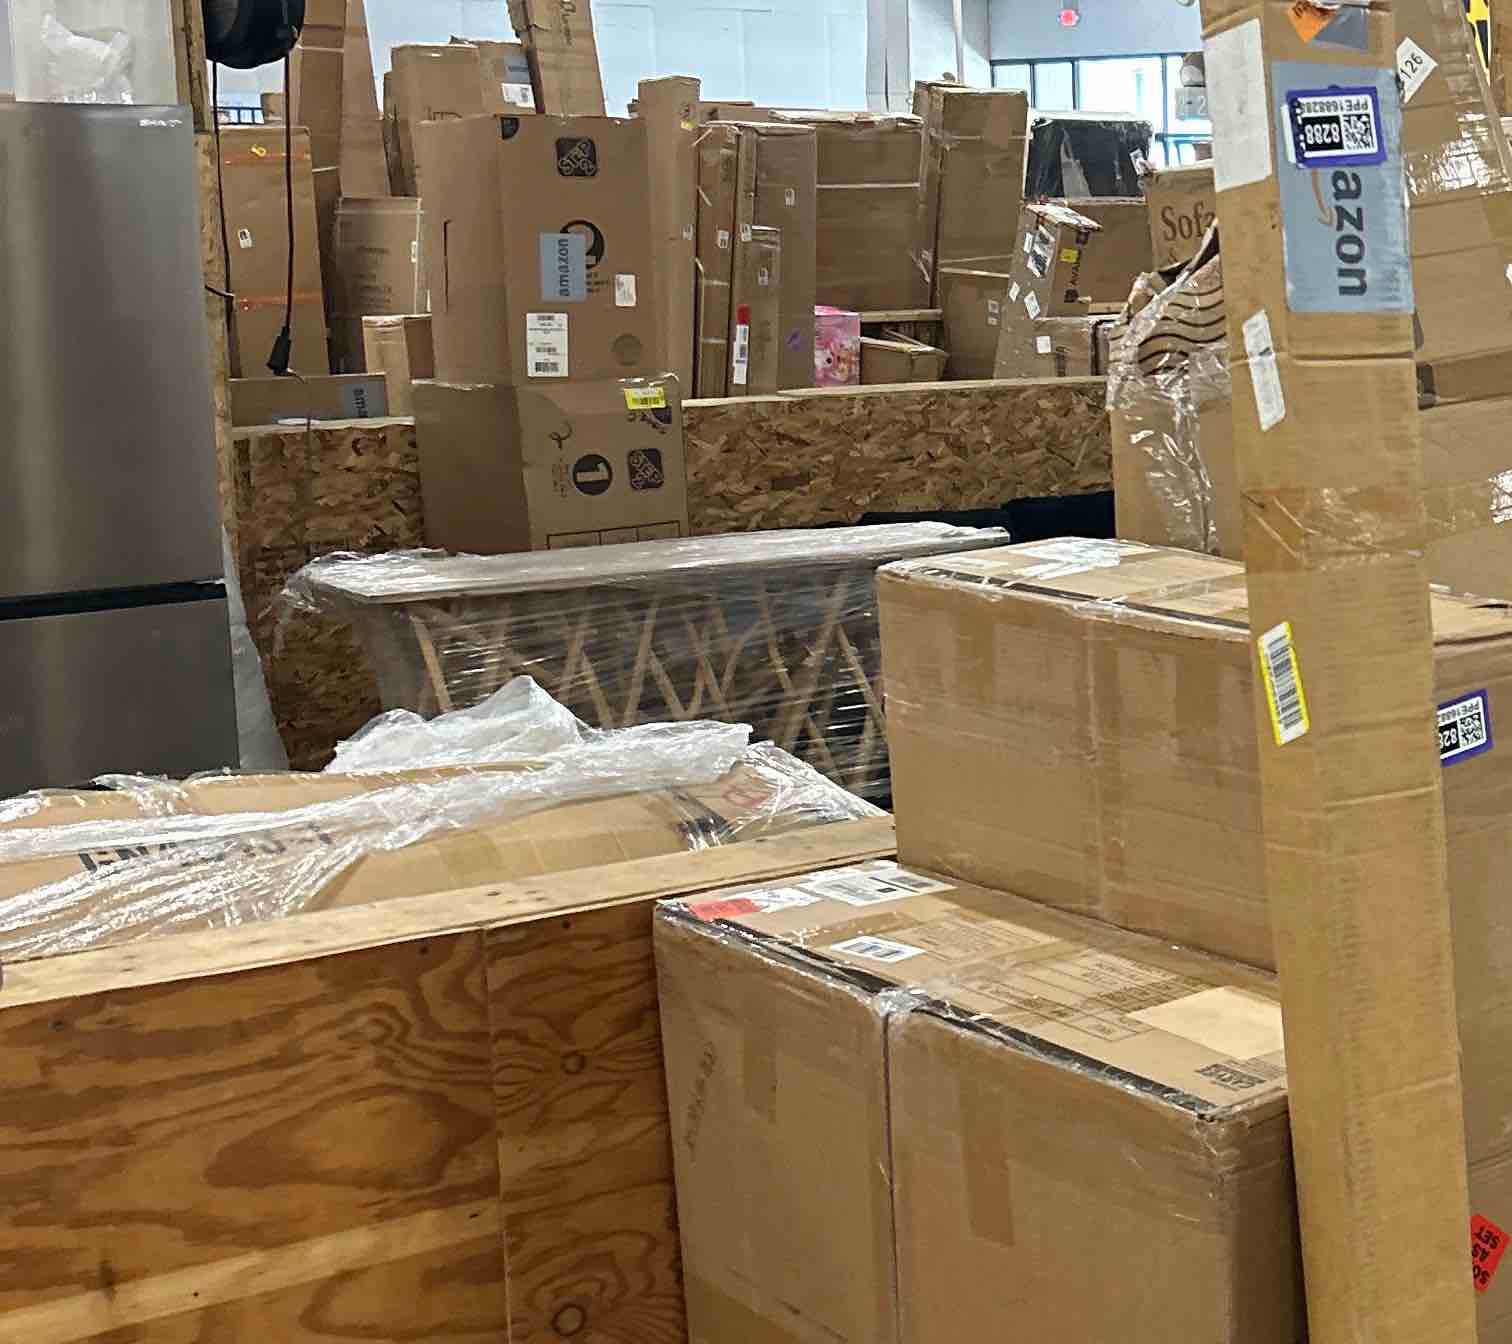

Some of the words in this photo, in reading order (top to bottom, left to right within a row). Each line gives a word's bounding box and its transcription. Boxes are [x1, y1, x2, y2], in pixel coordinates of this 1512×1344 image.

[1303, 122, 1341, 145] 8288
[1331, 169, 1368, 297] azon
[557, 237, 570, 298] amazon
[1438, 726, 1460, 749] 828
[1474, 1226, 1501, 1250] SET
[1471, 1243, 1490, 1263] AS
[1473, 1264, 1490, 1285] SO
